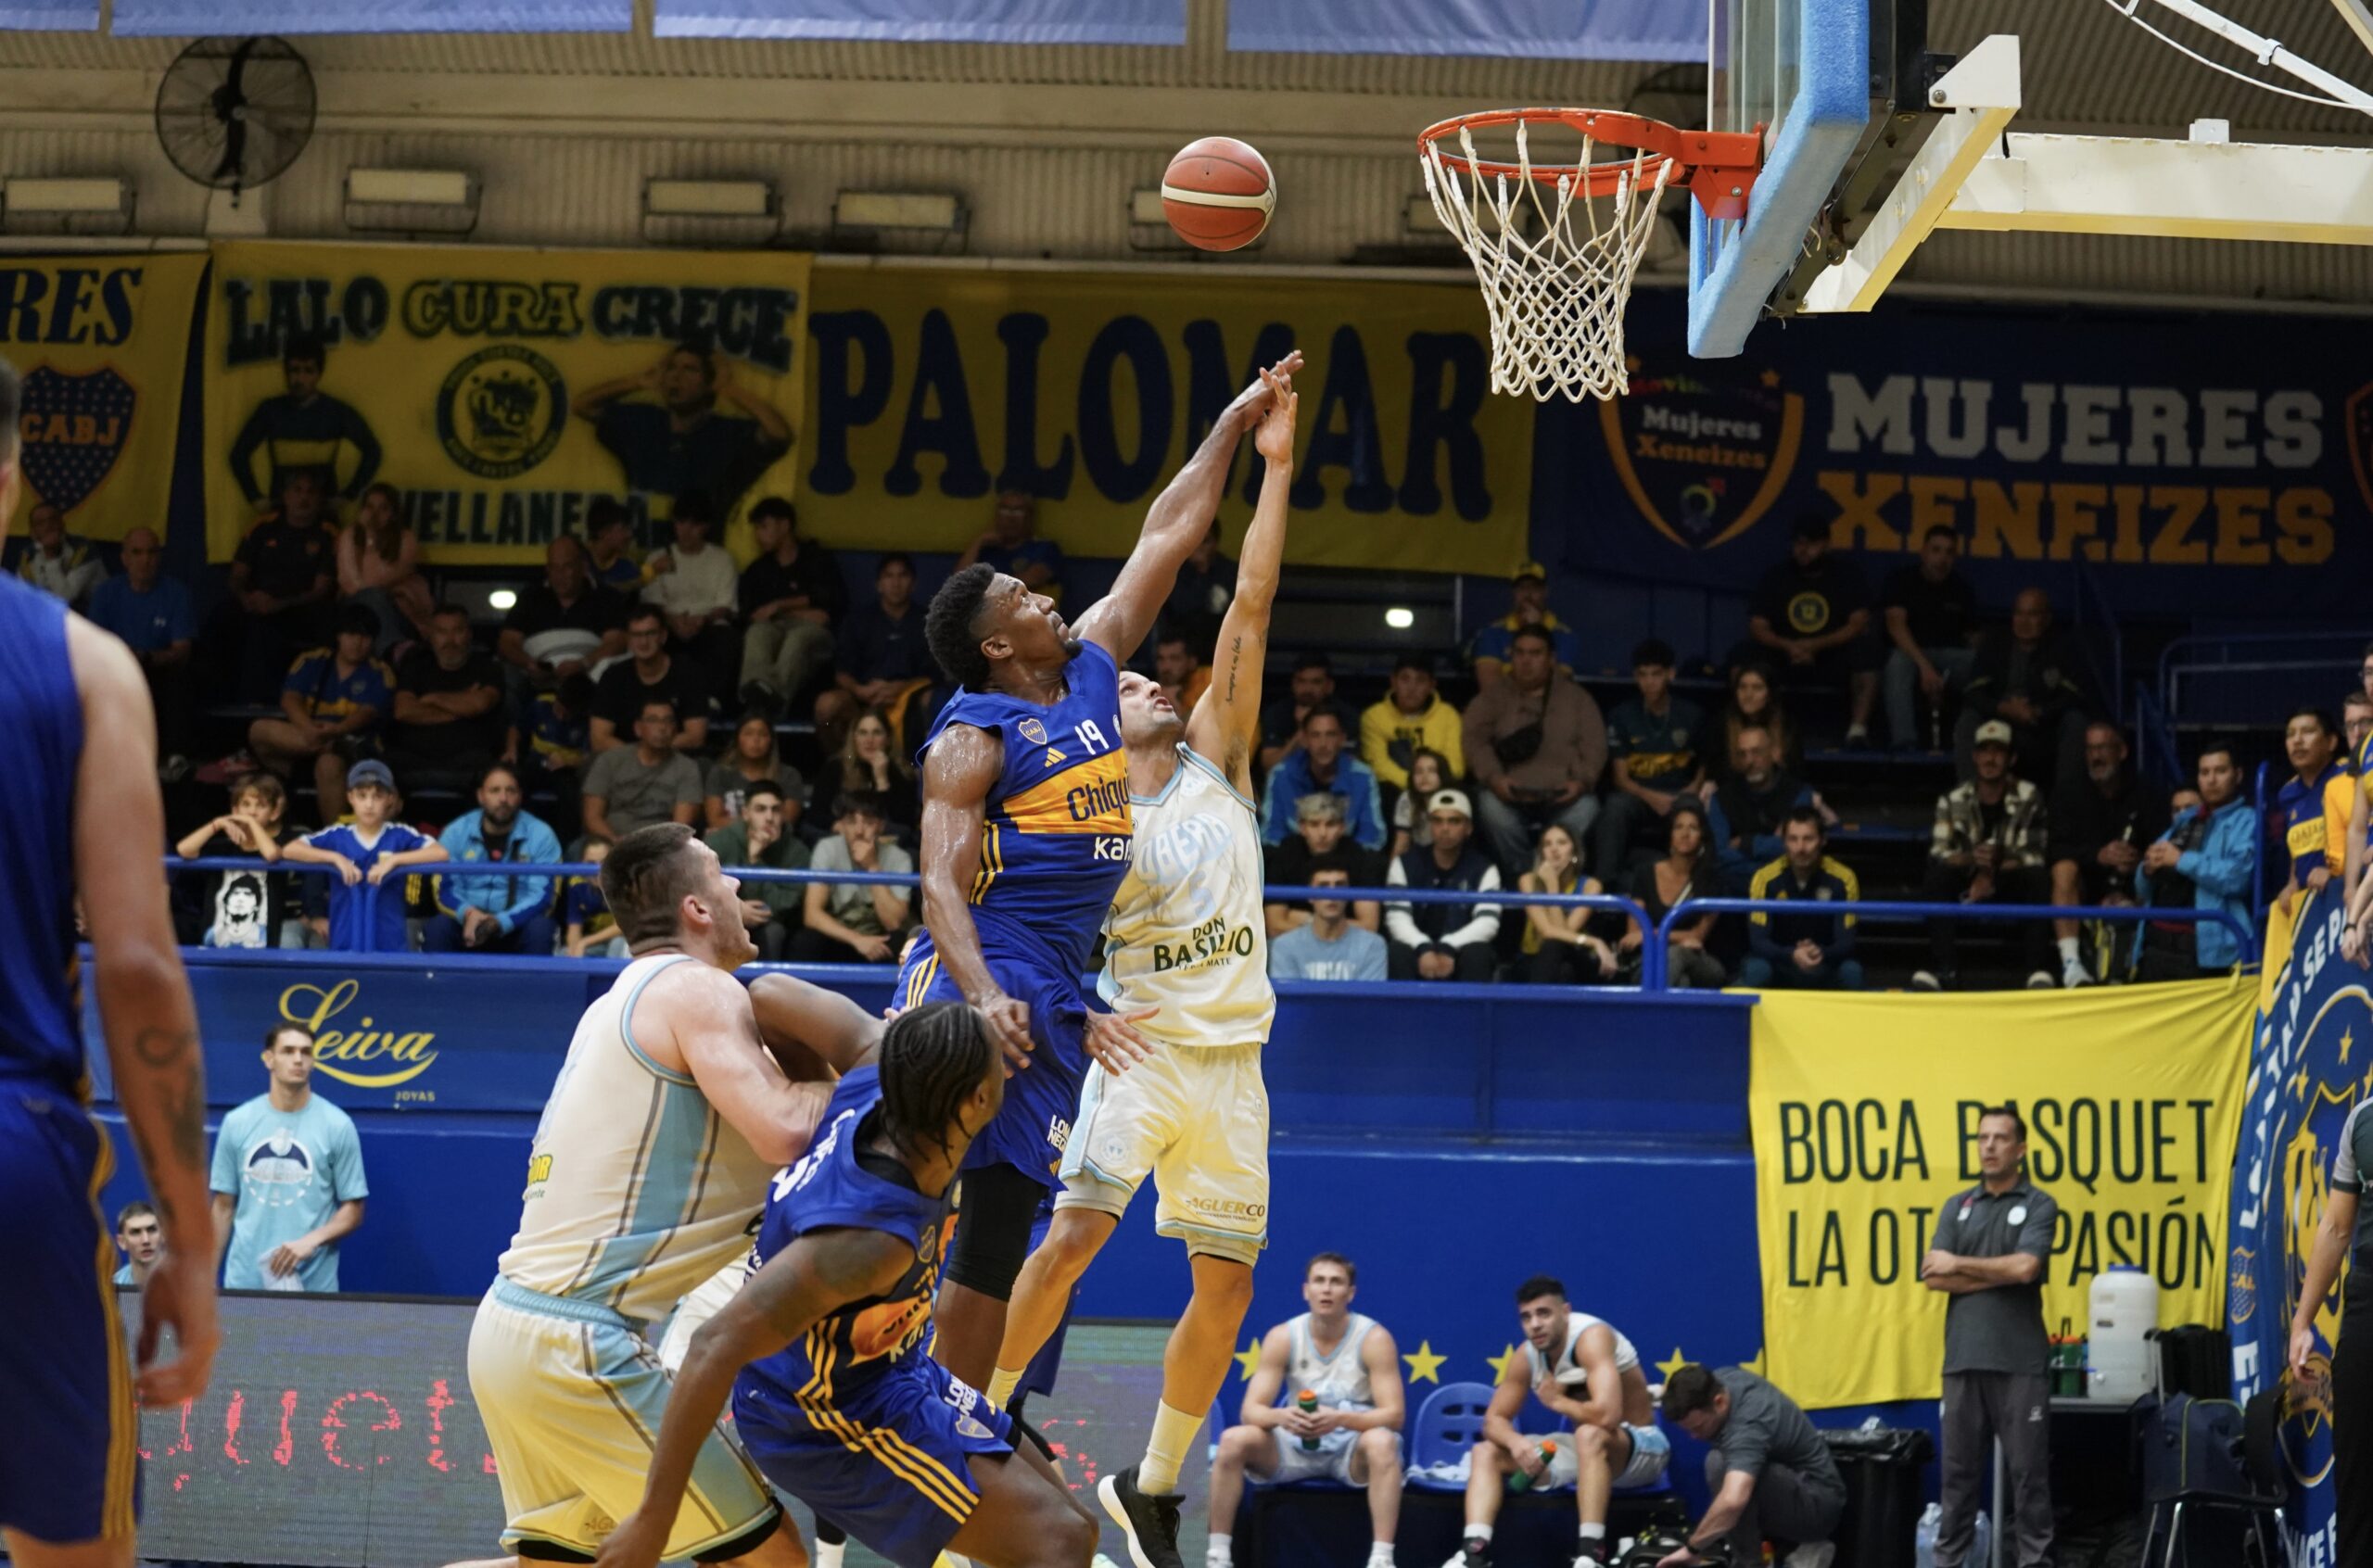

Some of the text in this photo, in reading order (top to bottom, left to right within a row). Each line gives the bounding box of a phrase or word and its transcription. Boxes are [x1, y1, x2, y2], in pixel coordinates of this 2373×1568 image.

[226, 275, 798, 374] LALO CURA CRECE
[808, 308, 1492, 522] PALOMAR
[1643, 404, 1762, 440] Mujeres
[1827, 372, 2323, 468] MUJERES
[1635, 432, 1767, 468] Xeneizes
[1075, 719, 1110, 755] 19
[1154, 925, 1254, 972] BASILIO
[1192, 917, 1225, 941] DON
[278, 979, 438, 1066] Leiva
[396, 1091, 436, 1103] JOYAS
[1780, 1099, 1930, 1184] BOCA
[1788, 1210, 1849, 1287] LA
